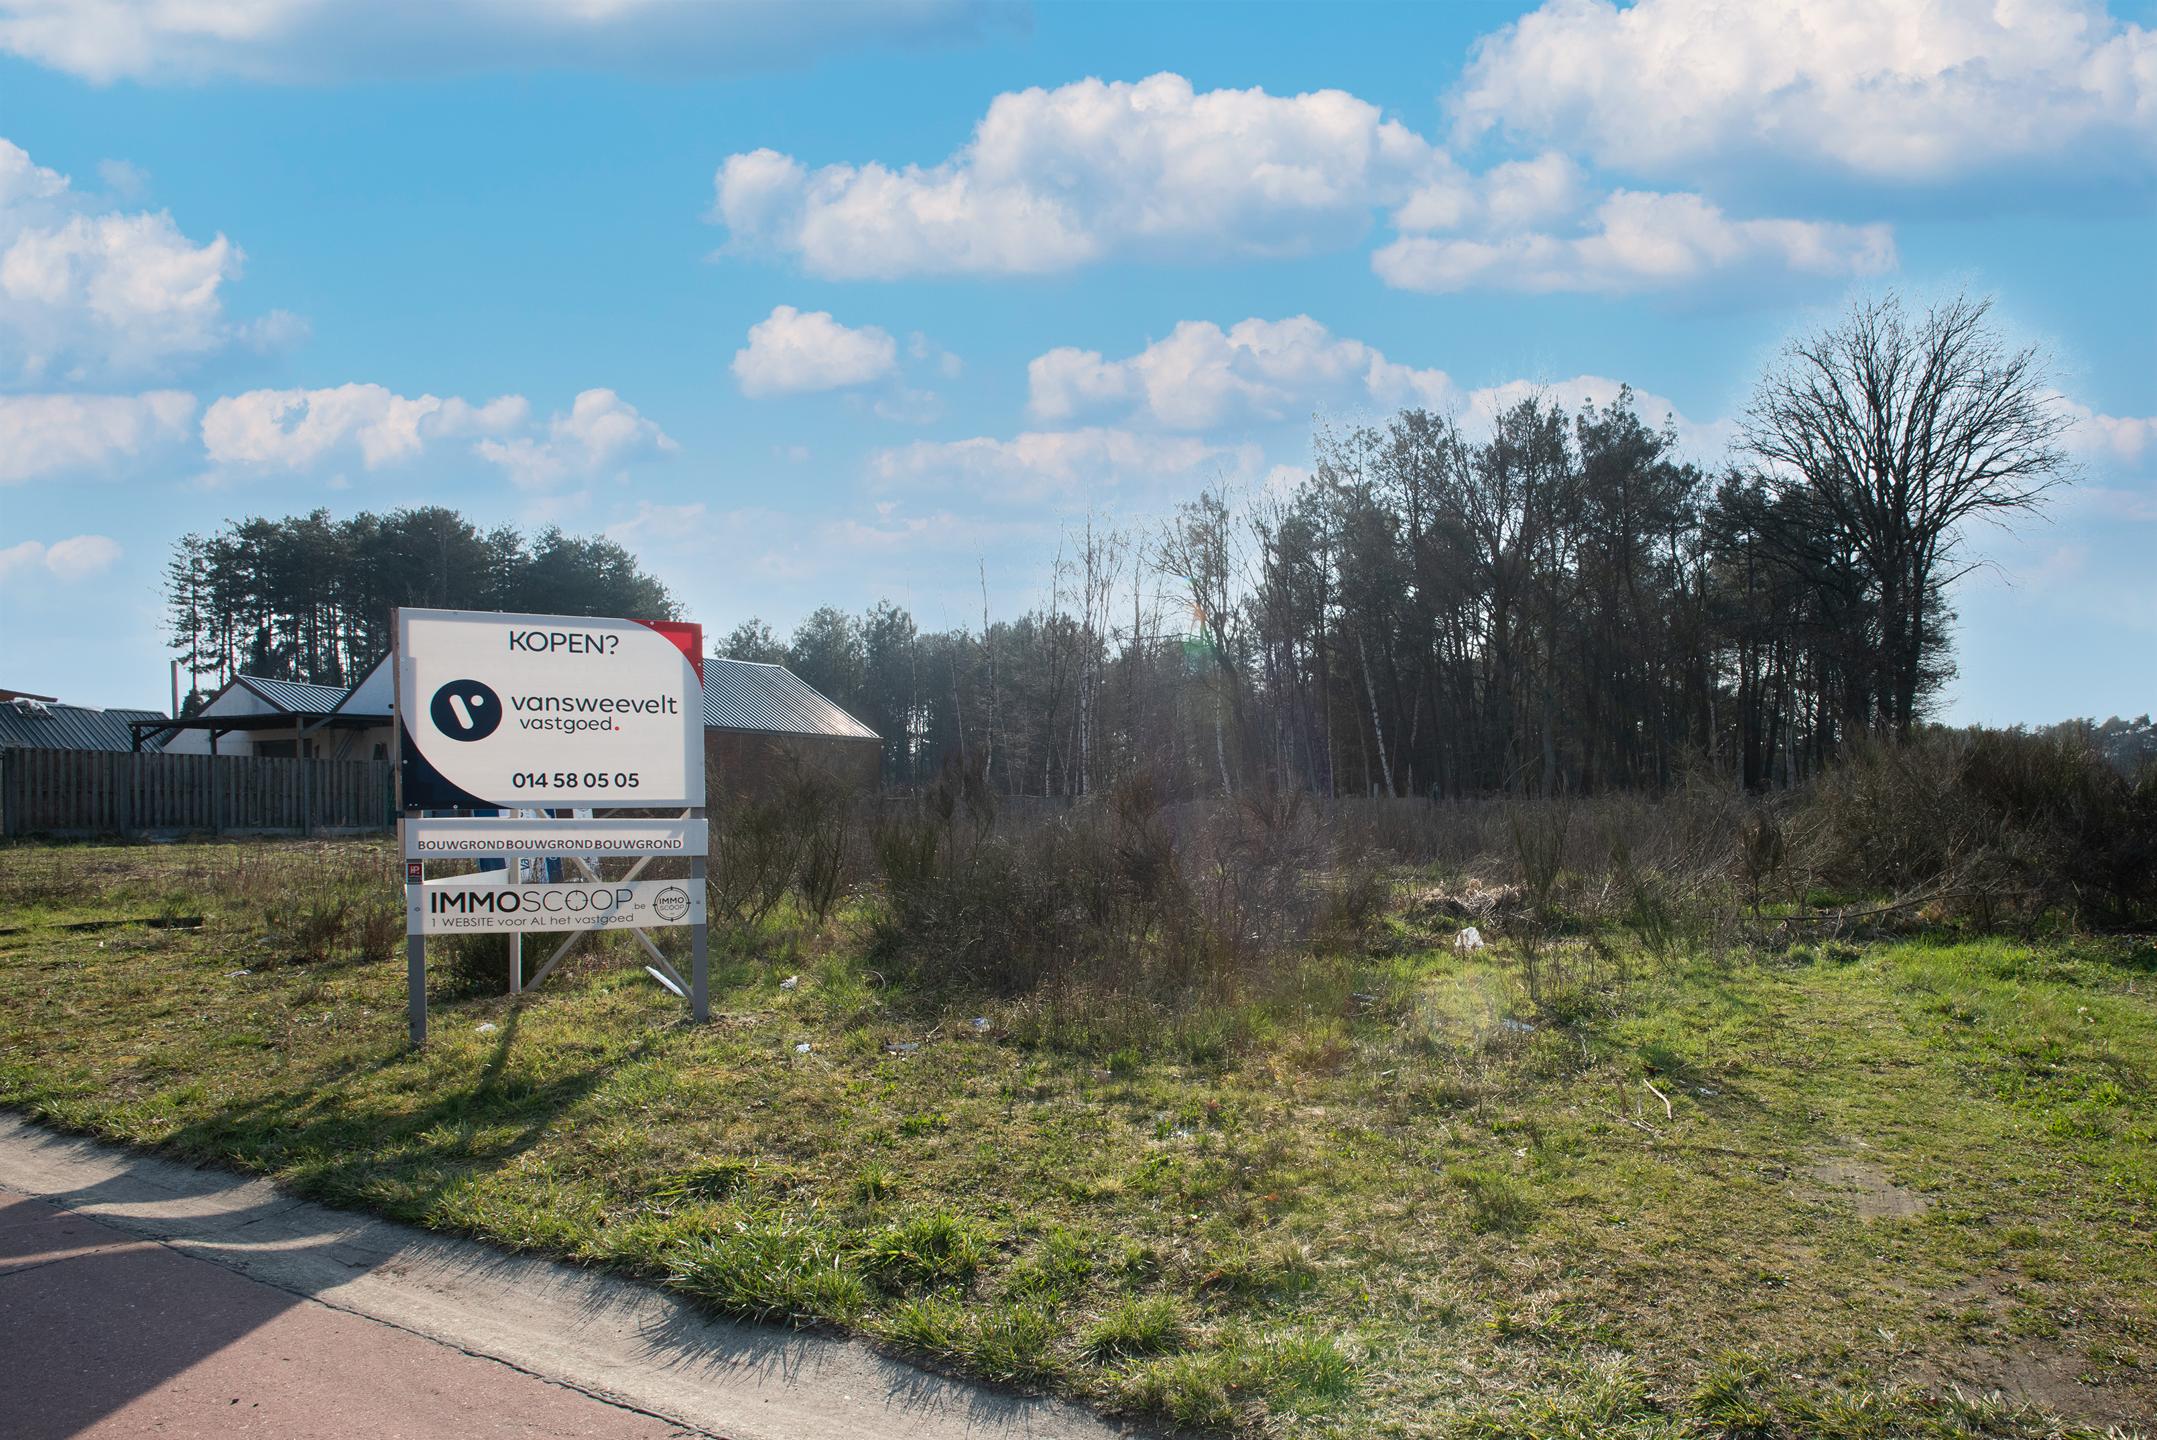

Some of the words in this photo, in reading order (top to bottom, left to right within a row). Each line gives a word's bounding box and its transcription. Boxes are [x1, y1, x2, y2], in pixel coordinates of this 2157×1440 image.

[510, 630, 619, 655] KOPEN?
[511, 695, 678, 714] vansweevelt
[512, 773, 548, 788] 014
[554, 773, 578, 788] 58
[583, 773, 609, 788] 05
[614, 773, 639, 788] 05
[659, 897, 685, 905] IMMO
[442, 917, 494, 927] WEBSITE
[497, 919, 526, 927] voor
[530, 917, 546, 926] AL
[550, 916, 571, 926] het
[575, 913, 634, 925] vastgoed
